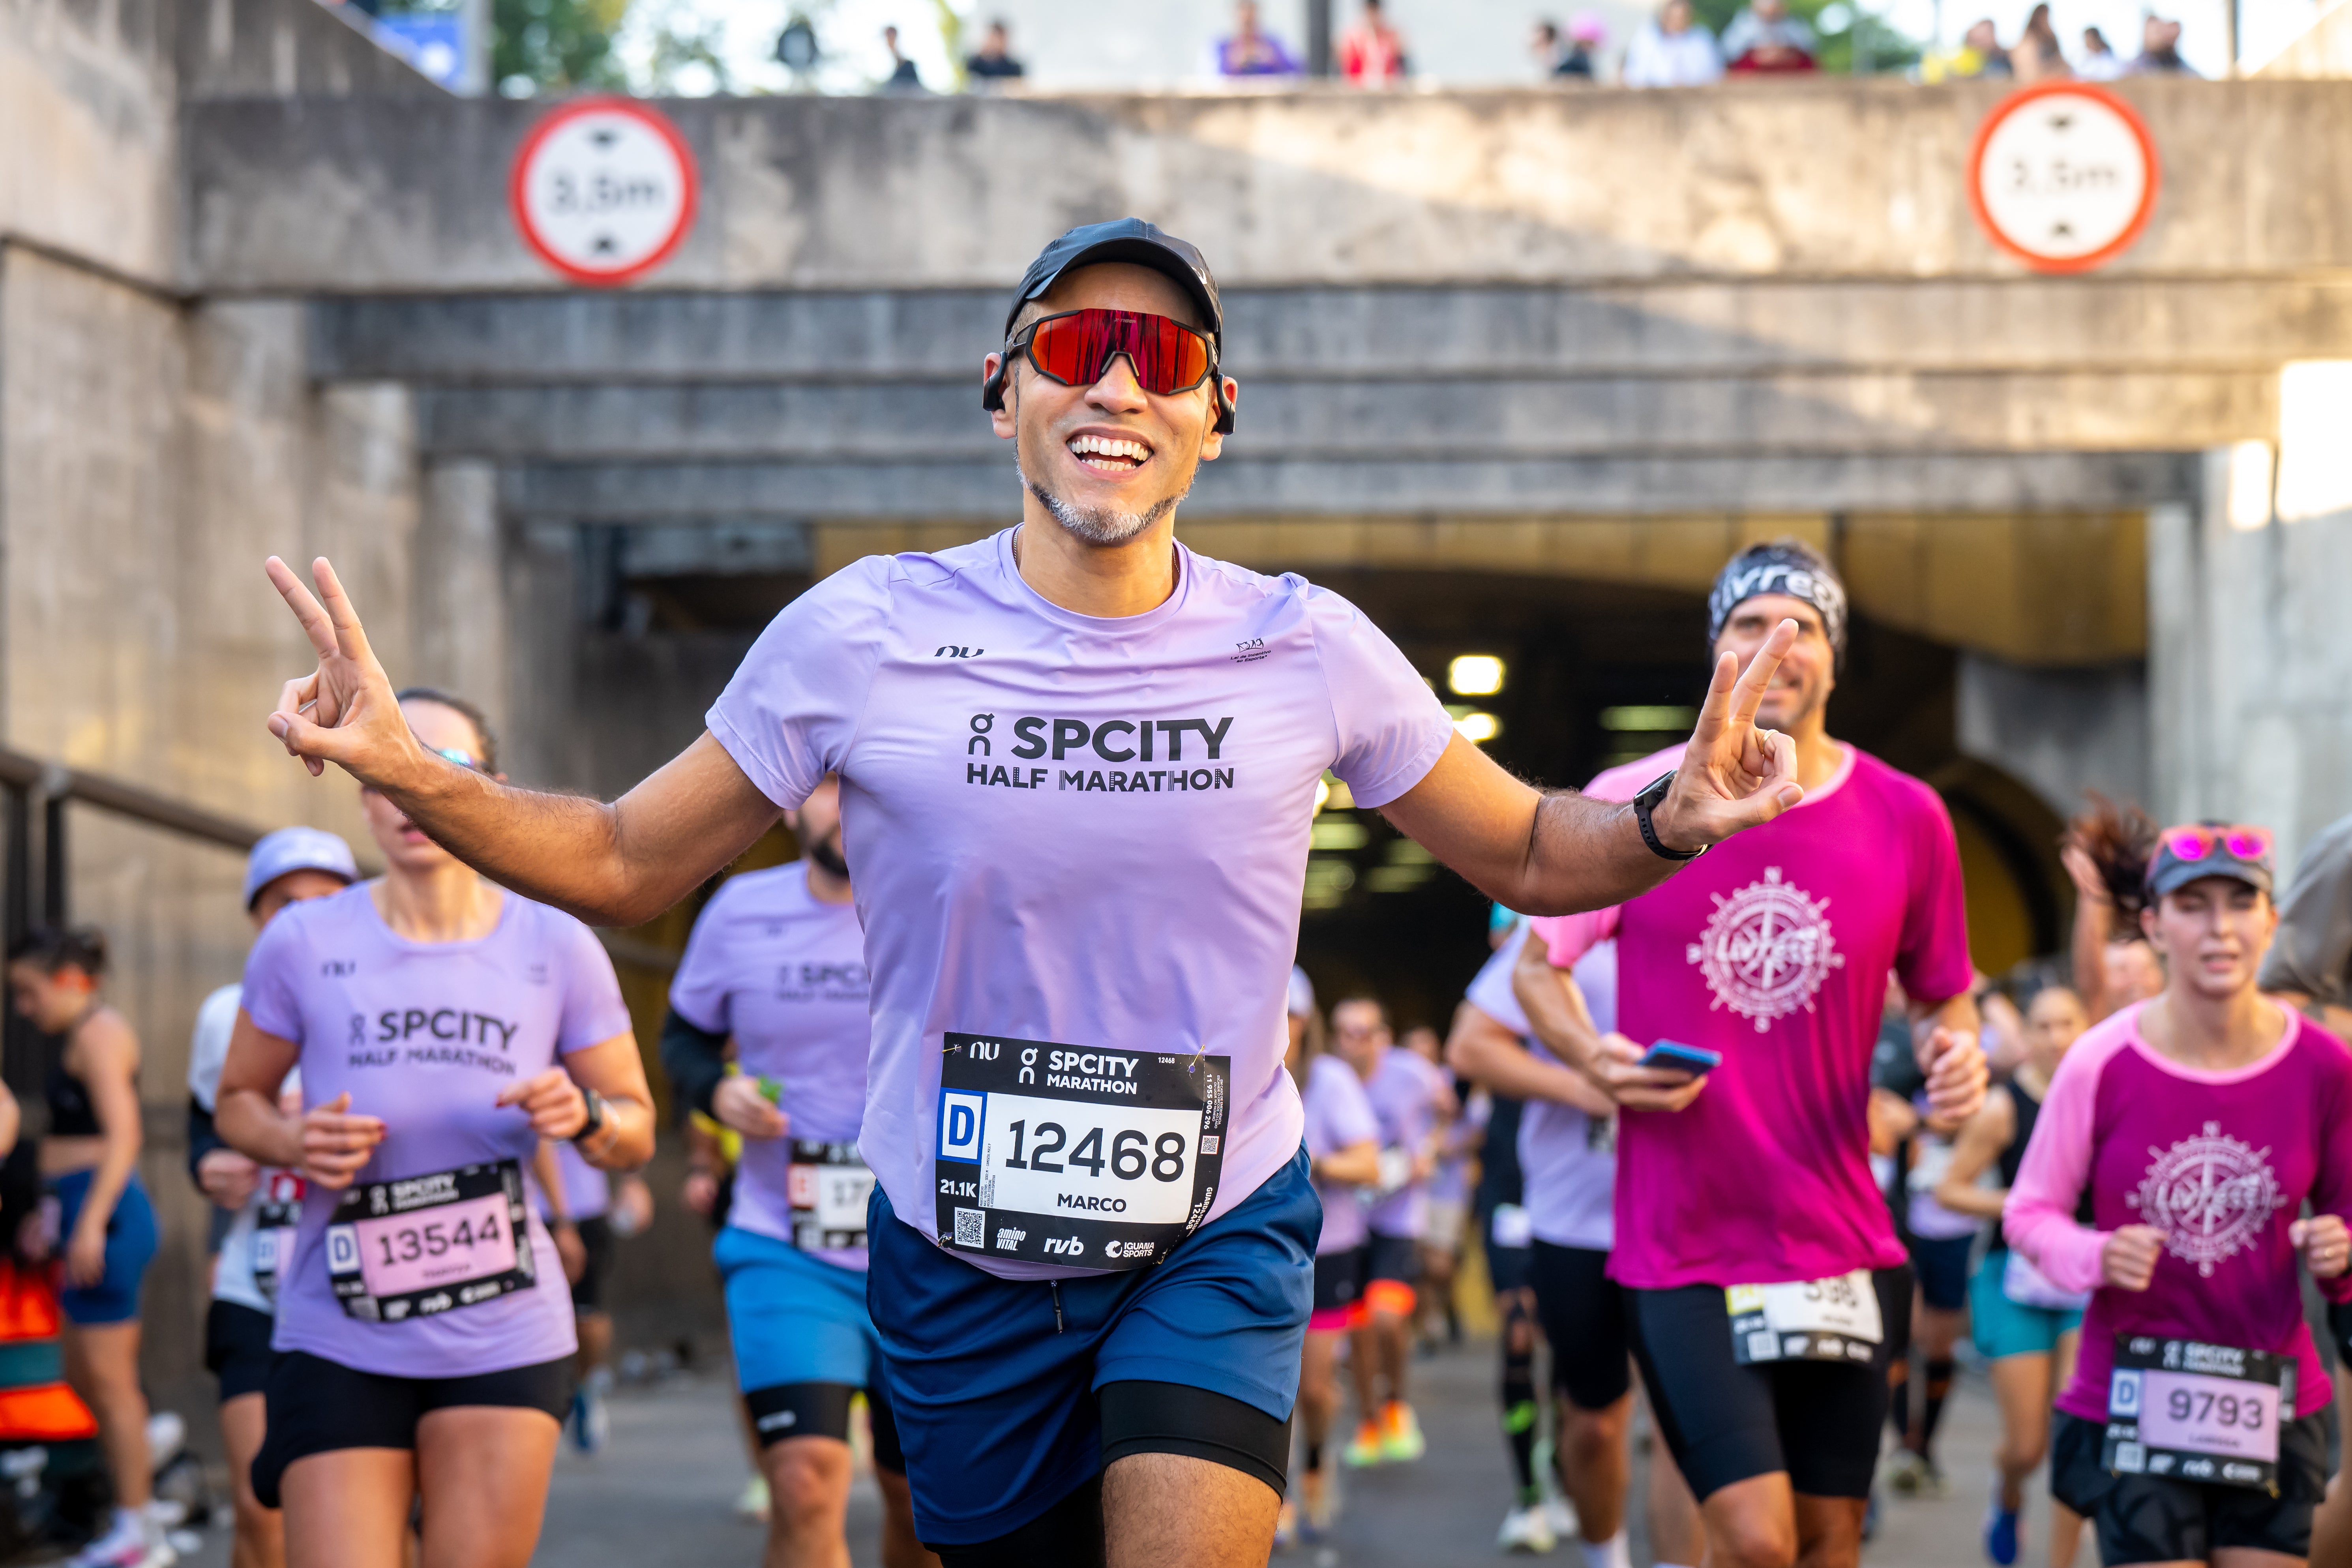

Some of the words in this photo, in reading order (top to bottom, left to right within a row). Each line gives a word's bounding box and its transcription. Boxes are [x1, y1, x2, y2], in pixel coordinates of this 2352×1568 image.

[1010, 716, 1234, 762] SPCITY
[967, 762, 1048, 789] HALF
[1059, 768, 1234, 792] MARATHON
[378, 1009, 519, 1052] SPCITY
[349, 1047, 396, 1068] HALF
[407, 1047, 517, 1077] MARATHON
[1048, 1051, 1139, 1077] SPCITY
[1047, 1074, 1138, 1094] MARATHON
[1207, 1073, 1212, 1082] 11
[949, 1104, 975, 1146] D
[1006, 1119, 1185, 1182] 12468
[940, 1179, 977, 1198] 21.1K
[1057, 1193, 1126, 1212] MARCO
[1186, 1203, 1202, 1230] 12468
[378, 1210, 500, 1266] 13544
[997, 1227, 1026, 1241] amino
[1044, 1236, 1084, 1255] rvb
[334, 1235, 352, 1262] D
[1123, 1249, 1153, 1257] SPORTS
[2118, 1381, 2134, 1404] D
[2168, 1388, 2264, 1430] 9793
